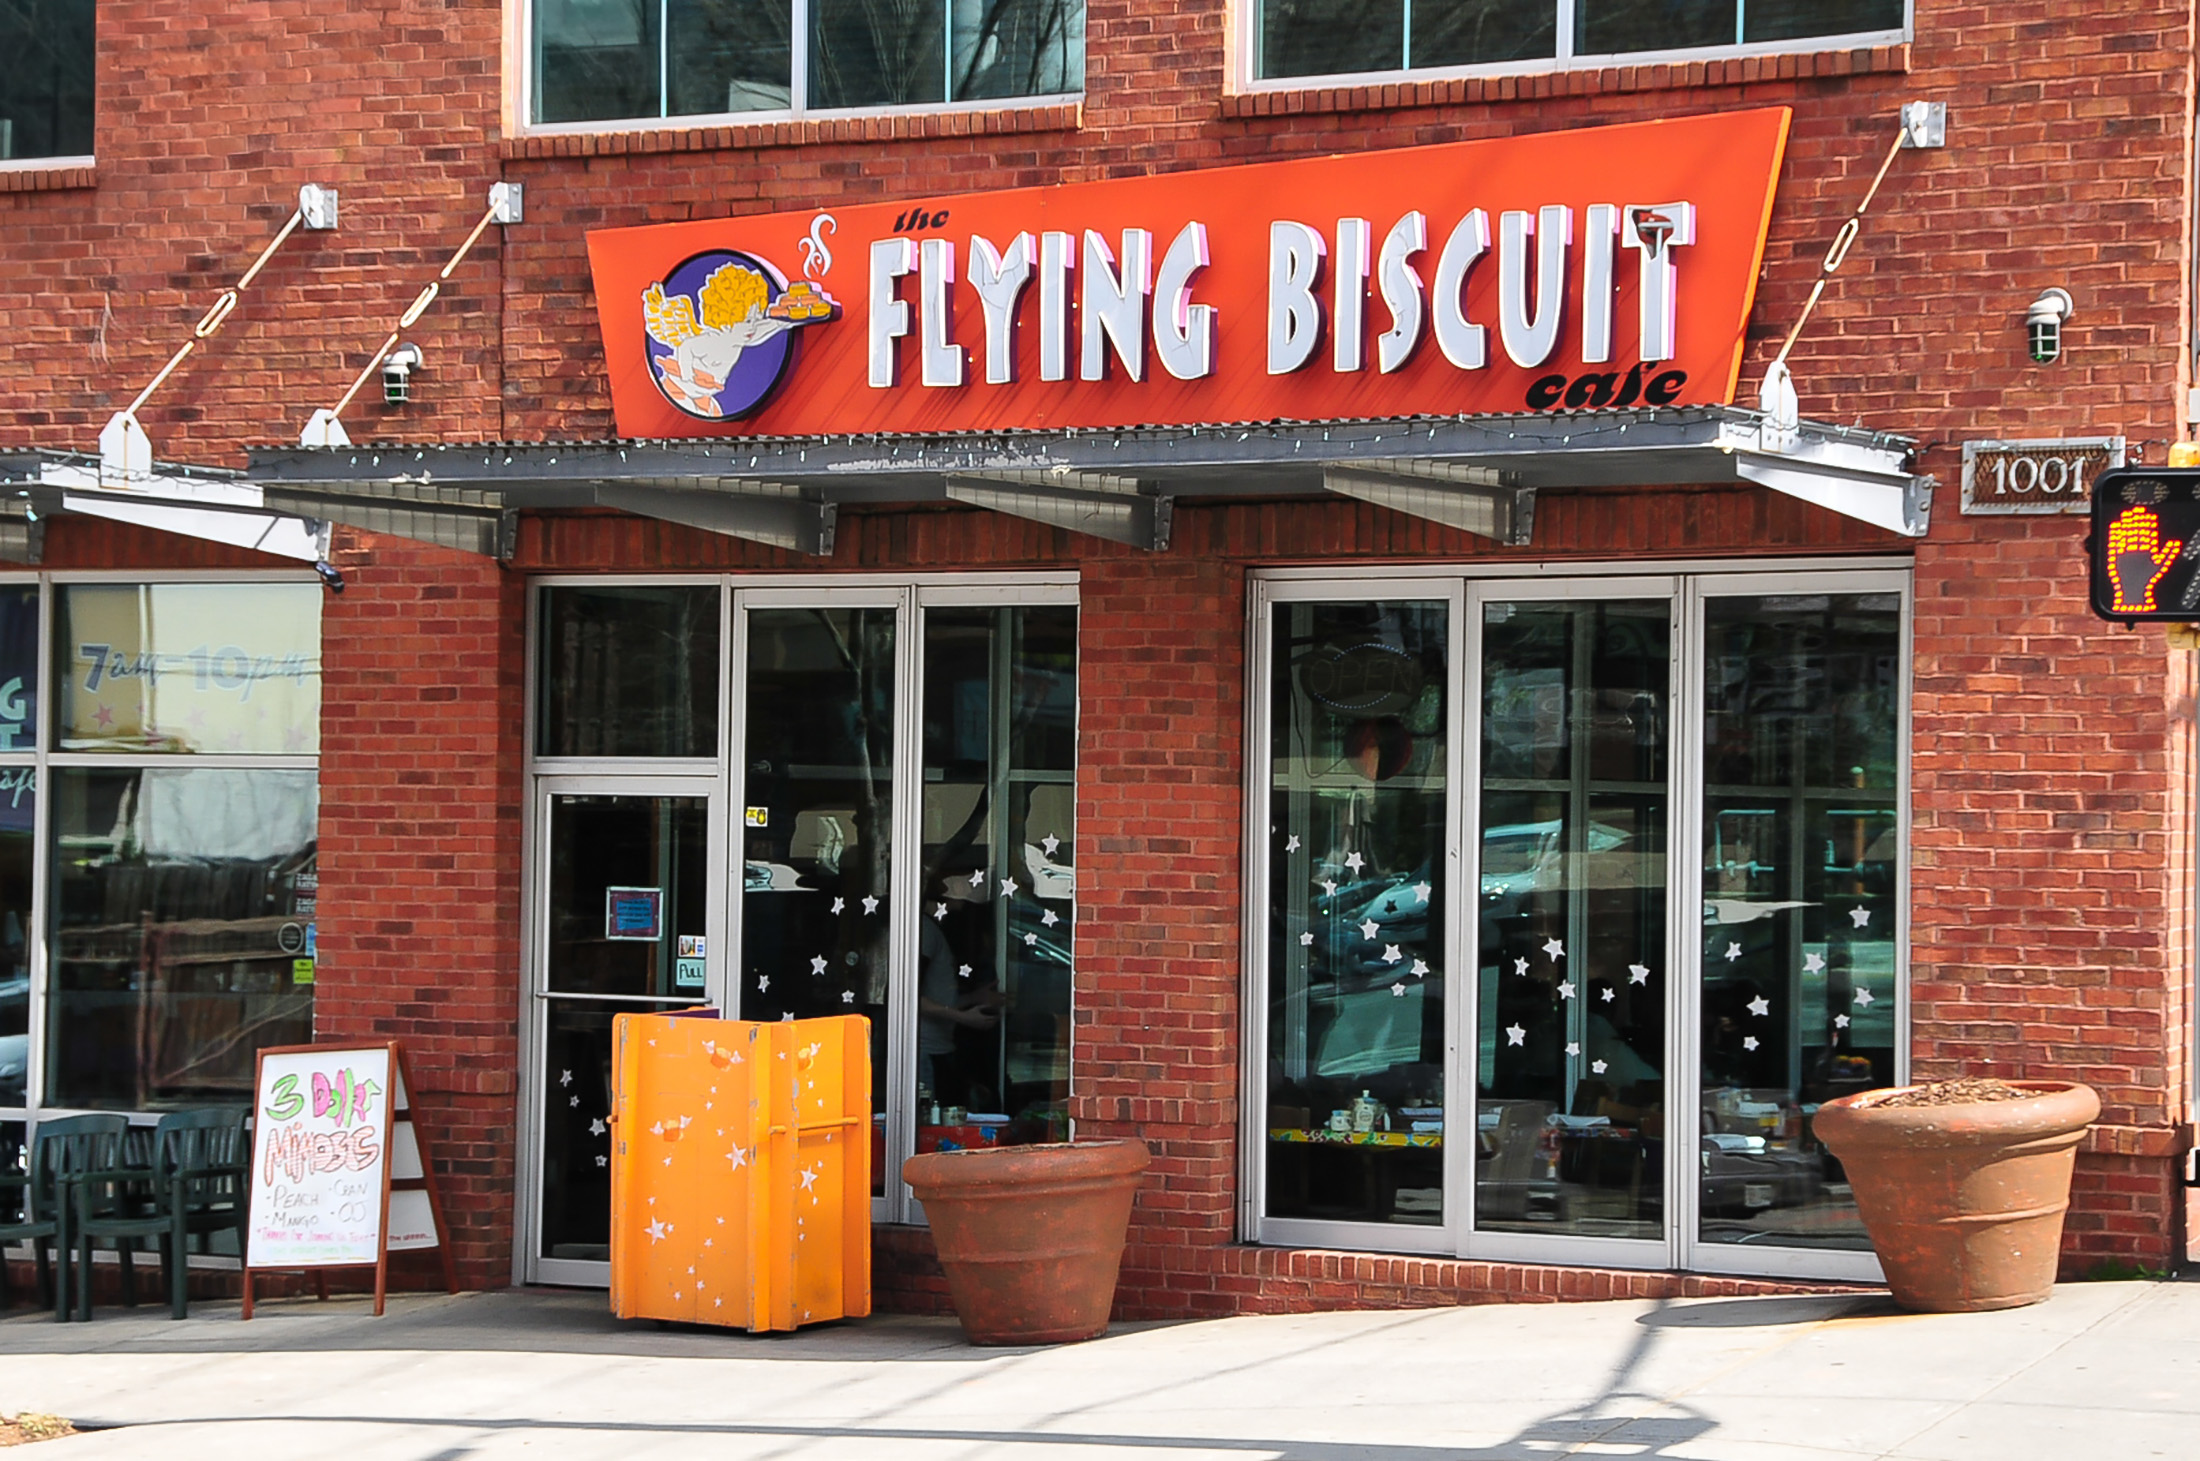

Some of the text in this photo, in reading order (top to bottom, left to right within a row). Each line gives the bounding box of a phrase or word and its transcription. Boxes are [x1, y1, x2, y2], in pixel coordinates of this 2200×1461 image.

[893, 207, 949, 232] the
[867, 201, 1695, 388] FLYING BISCUIT
[1525, 363, 1687, 410] cafe
[1990, 456, 2086, 495] 1001
[1310, 658, 1414, 694] OPEN
[265, 1074, 305, 1121] 3
